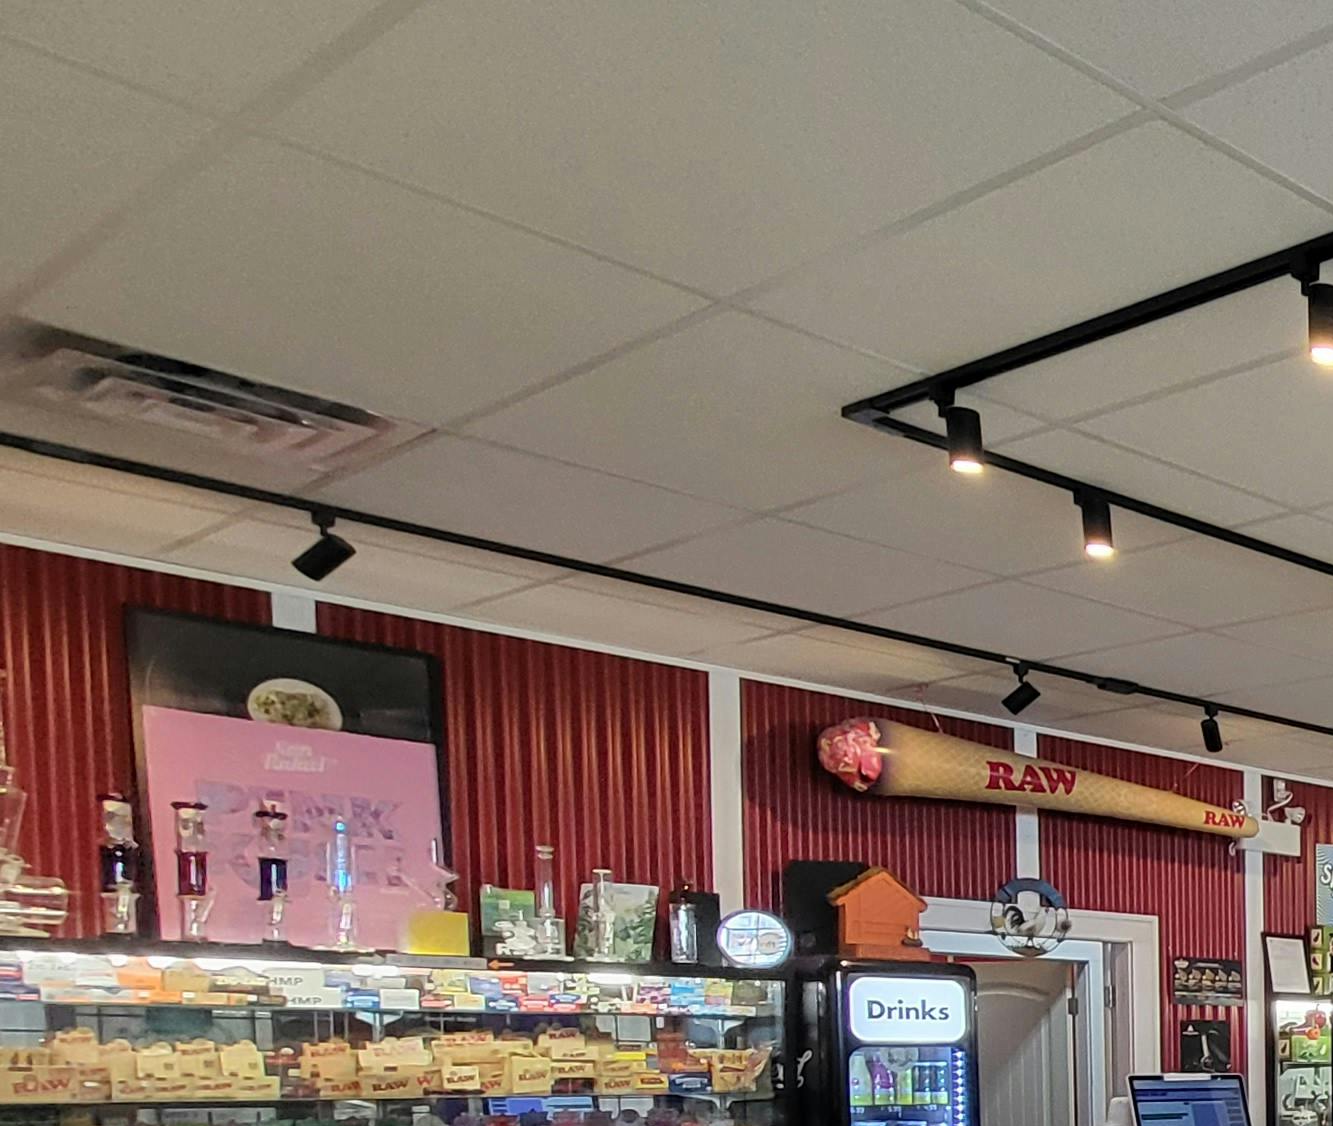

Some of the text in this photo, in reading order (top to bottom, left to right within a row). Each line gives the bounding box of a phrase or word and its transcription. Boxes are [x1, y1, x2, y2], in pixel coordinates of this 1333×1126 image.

[985, 761, 1077, 796] RAW
[1203, 811, 1246, 828] RAW
[867, 999, 950, 1021] Drinks
[372, 1080, 409, 1092] RAW
[446, 1074, 476, 1084] RAW
